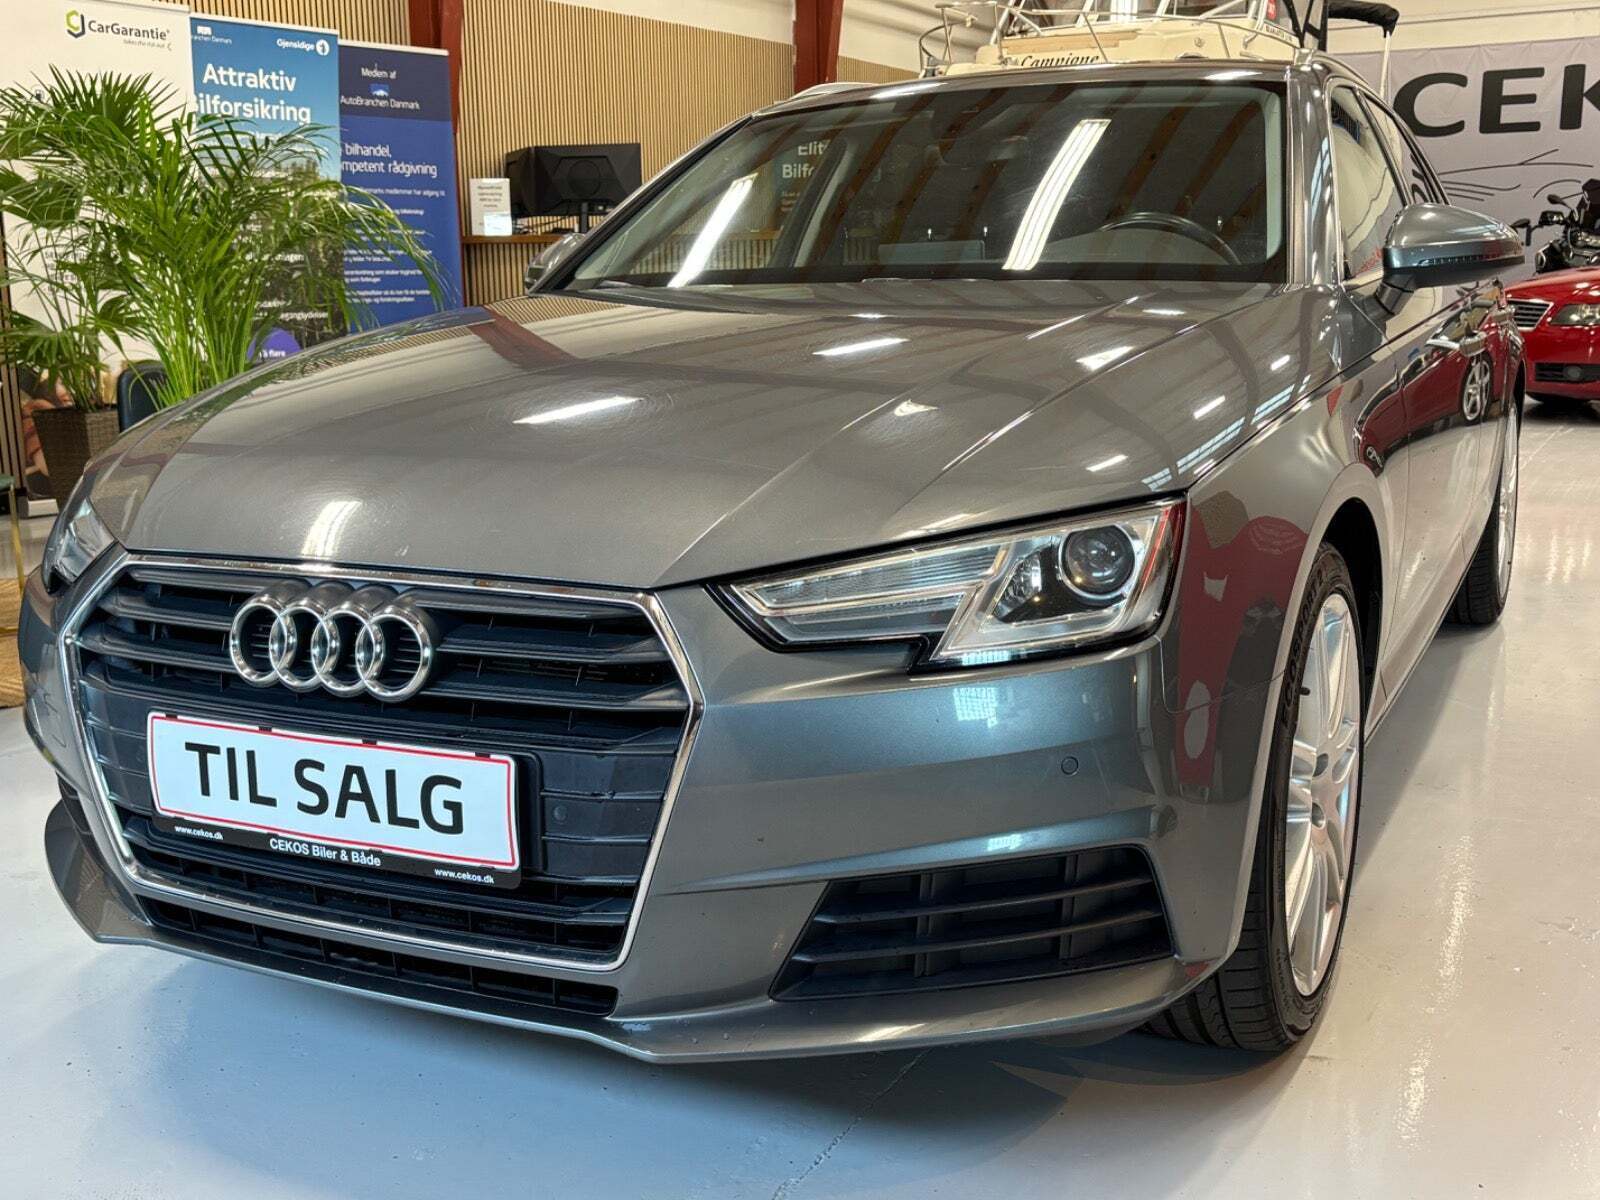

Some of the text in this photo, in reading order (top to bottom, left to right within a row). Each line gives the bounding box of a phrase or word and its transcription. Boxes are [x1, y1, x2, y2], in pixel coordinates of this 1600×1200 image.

[88, 20, 168, 40] CarGarantie
[277, 38, 315, 51] Gjensidige
[202, 63, 297, 92] Attraktiv
[390, 98, 420, 110] Danmark
[344, 143, 392, 158] bilhandel,
[388, 160, 438, 178] rådgivning
[184, 741, 464, 835] TIL SALG
[174, 825, 224, 841] www.cekos.dk
[269, 838, 382, 867] CEKOS Biler & Både
[434, 867, 495, 884] www.cekos.dk
